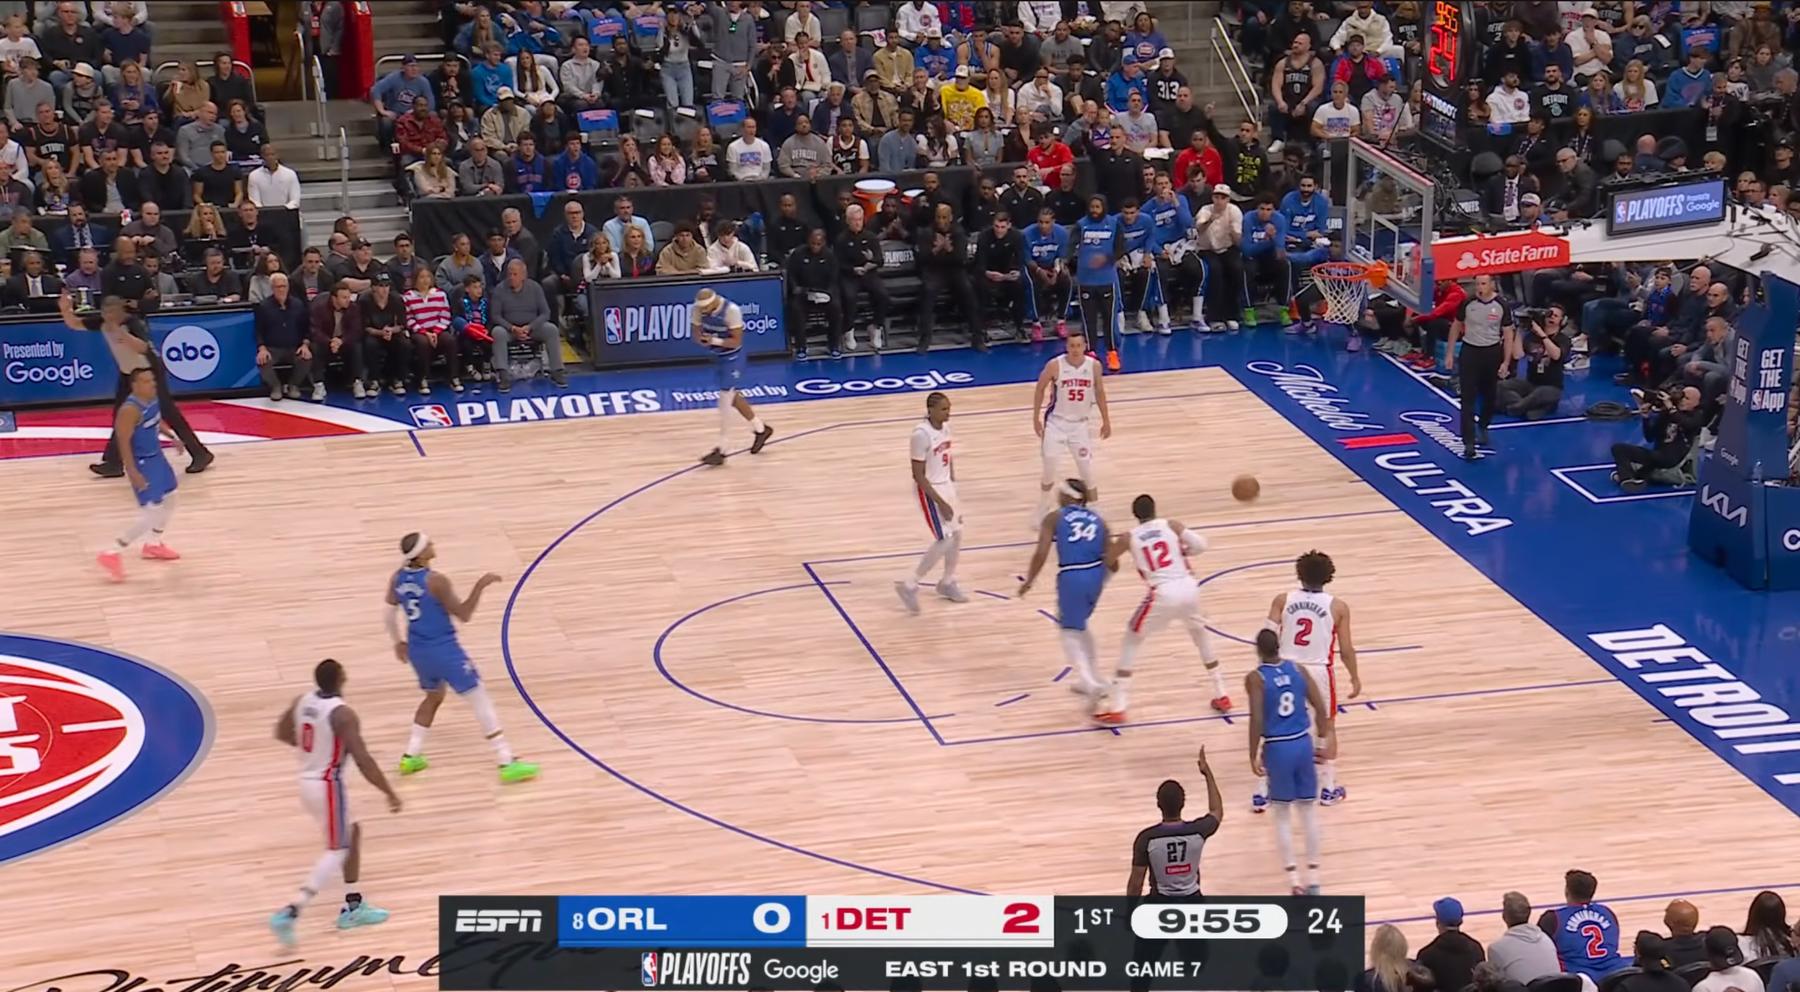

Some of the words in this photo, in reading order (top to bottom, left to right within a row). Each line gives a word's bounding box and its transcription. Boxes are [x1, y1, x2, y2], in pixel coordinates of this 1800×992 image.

[1429, 23, 1457, 81] 24
[1156, 80, 1179, 100] 313
[1542, 94, 1569, 107] DETROIT
[1627, 194, 1685, 222] PLAYOFFS
[1686, 200, 1720, 212] Google
[624, 304, 692, 343] PLAYO
[742, 314, 777, 334] ogle
[3, 342, 50, 360] Presented
[52, 341, 64, 360] by
[165, 342, 217, 363] abc
[1761, 348, 1785, 369] GET
[5, 359, 94, 386] Google
[1061, 377, 1093, 389] PISTONS
[1759, 369, 1783, 388] THE
[456, 389, 662, 426] PLAYOFFS
[671, 385, 761, 403] Presed
[763, 384, 788, 397] by
[794, 369, 975, 394] Google
[1068, 389, 1086, 402] 55
[1246, 361, 1386, 432] Michelob
[1762, 389, 1786, 413] App
[1374, 451, 1514, 537] ULTRA
[1067, 521, 1099, 543] 34
[1142, 540, 1174, 573] 12
[407, 599, 422, 621] 5
[1286, 601, 1329, 619] CUNNINGHAM
[1294, 617, 1314, 647] 2
[1278, 690, 1296, 717] 8
[1166, 840, 1188, 864] 27
[1565, 909, 1612, 933] CUNNINGHAM
[1581, 923, 1609, 959] 2
